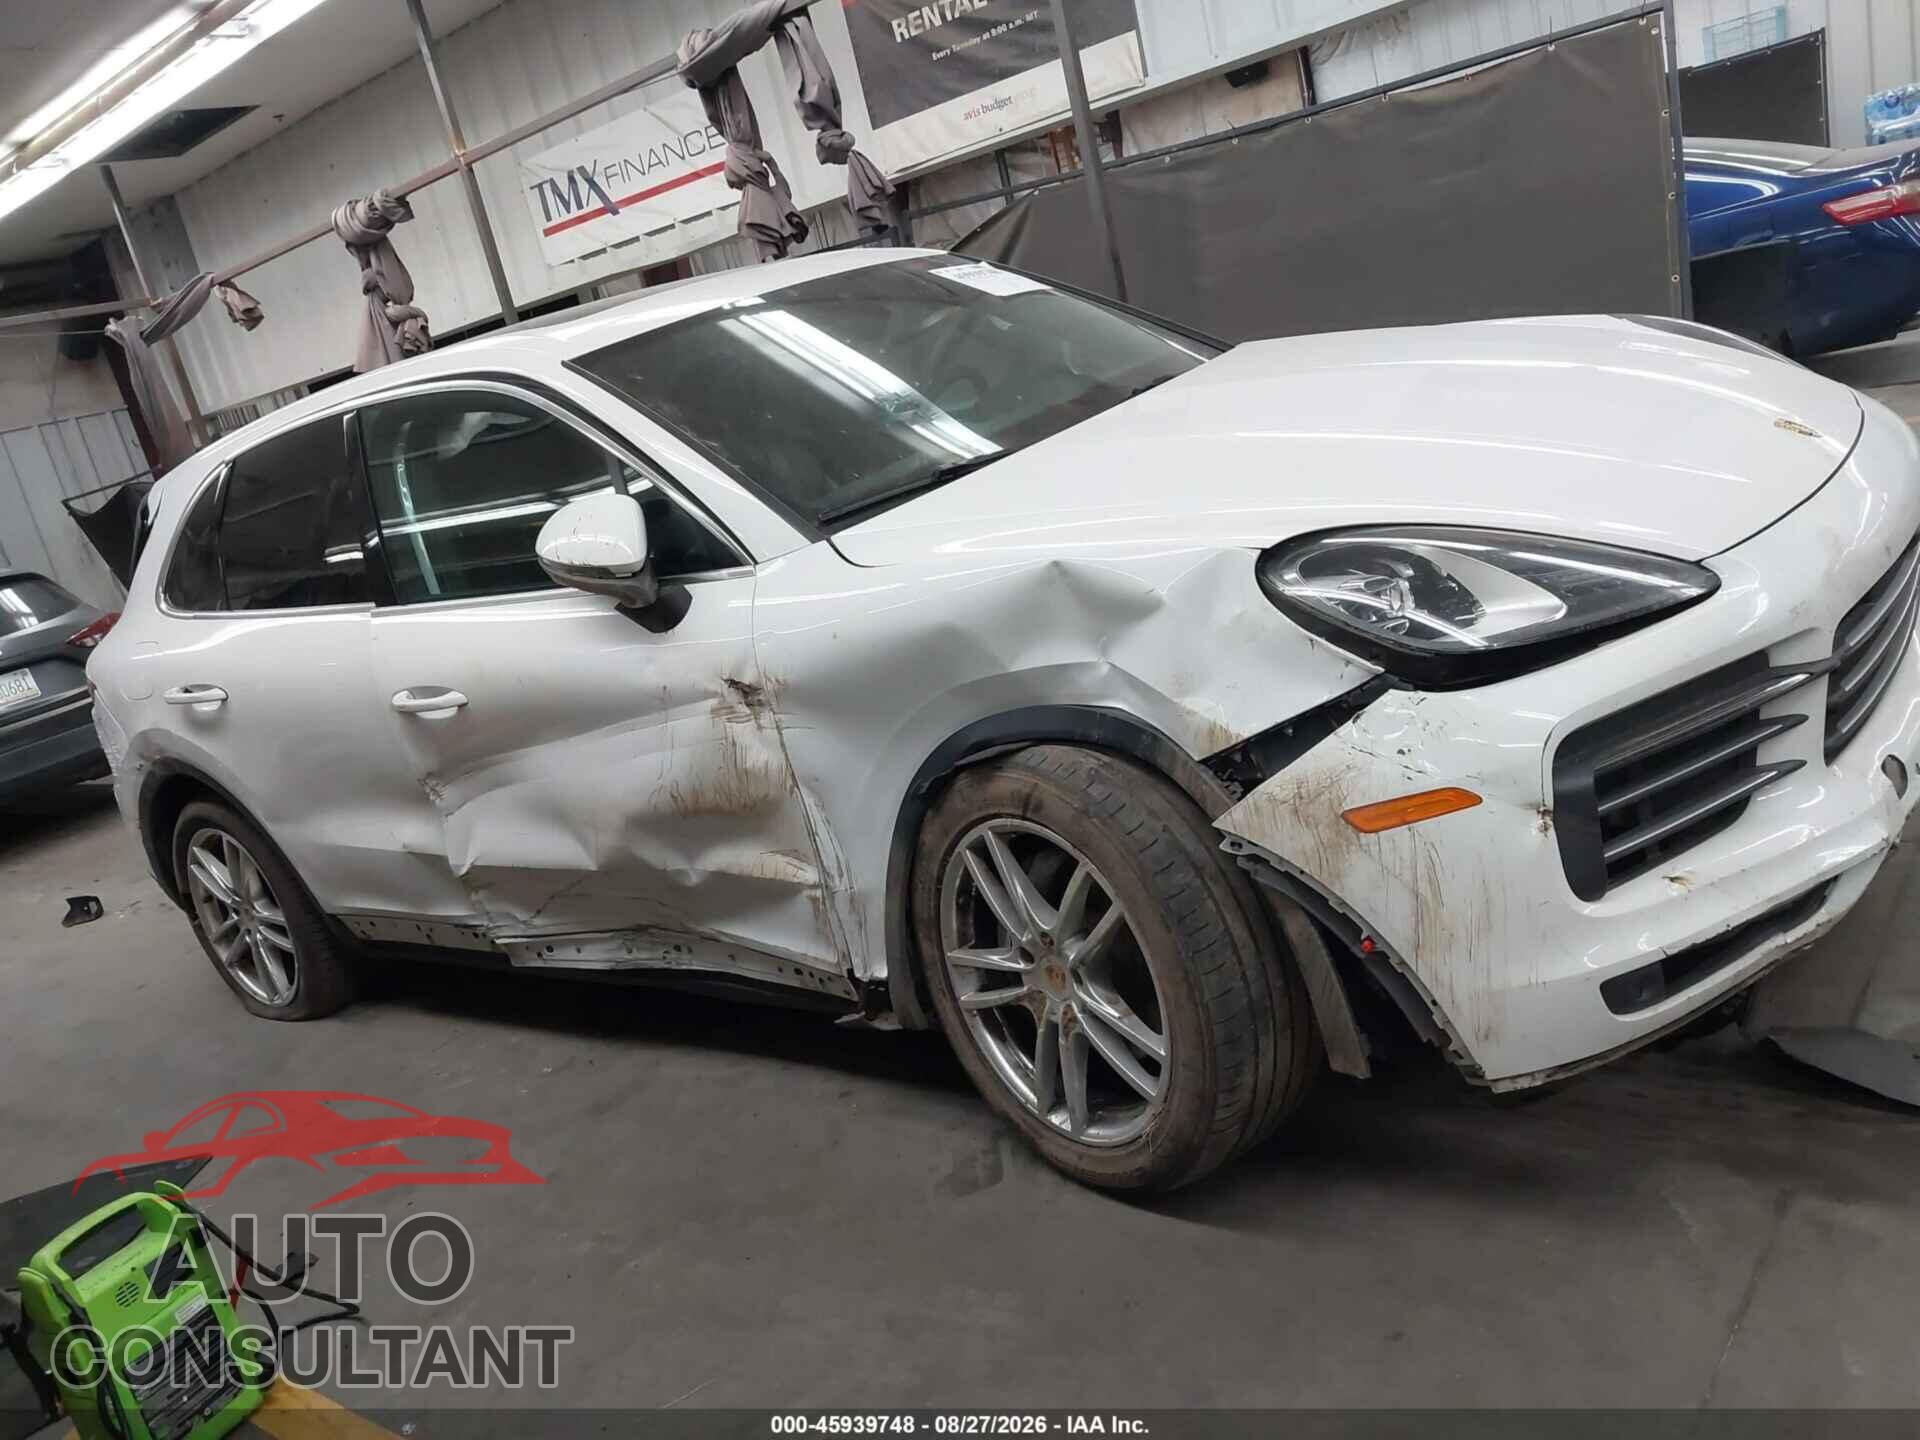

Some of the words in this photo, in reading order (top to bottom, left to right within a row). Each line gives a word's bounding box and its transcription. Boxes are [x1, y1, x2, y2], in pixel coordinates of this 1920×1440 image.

[931, 49, 951, 61] Every
[990, 23, 1008, 37] 9:00
[981, 95, 1014, 114] budget
[529, 159, 620, 223] TMX
[603, 124, 727, 190] FINANCE
[0, 676, 33, 699] 0681
